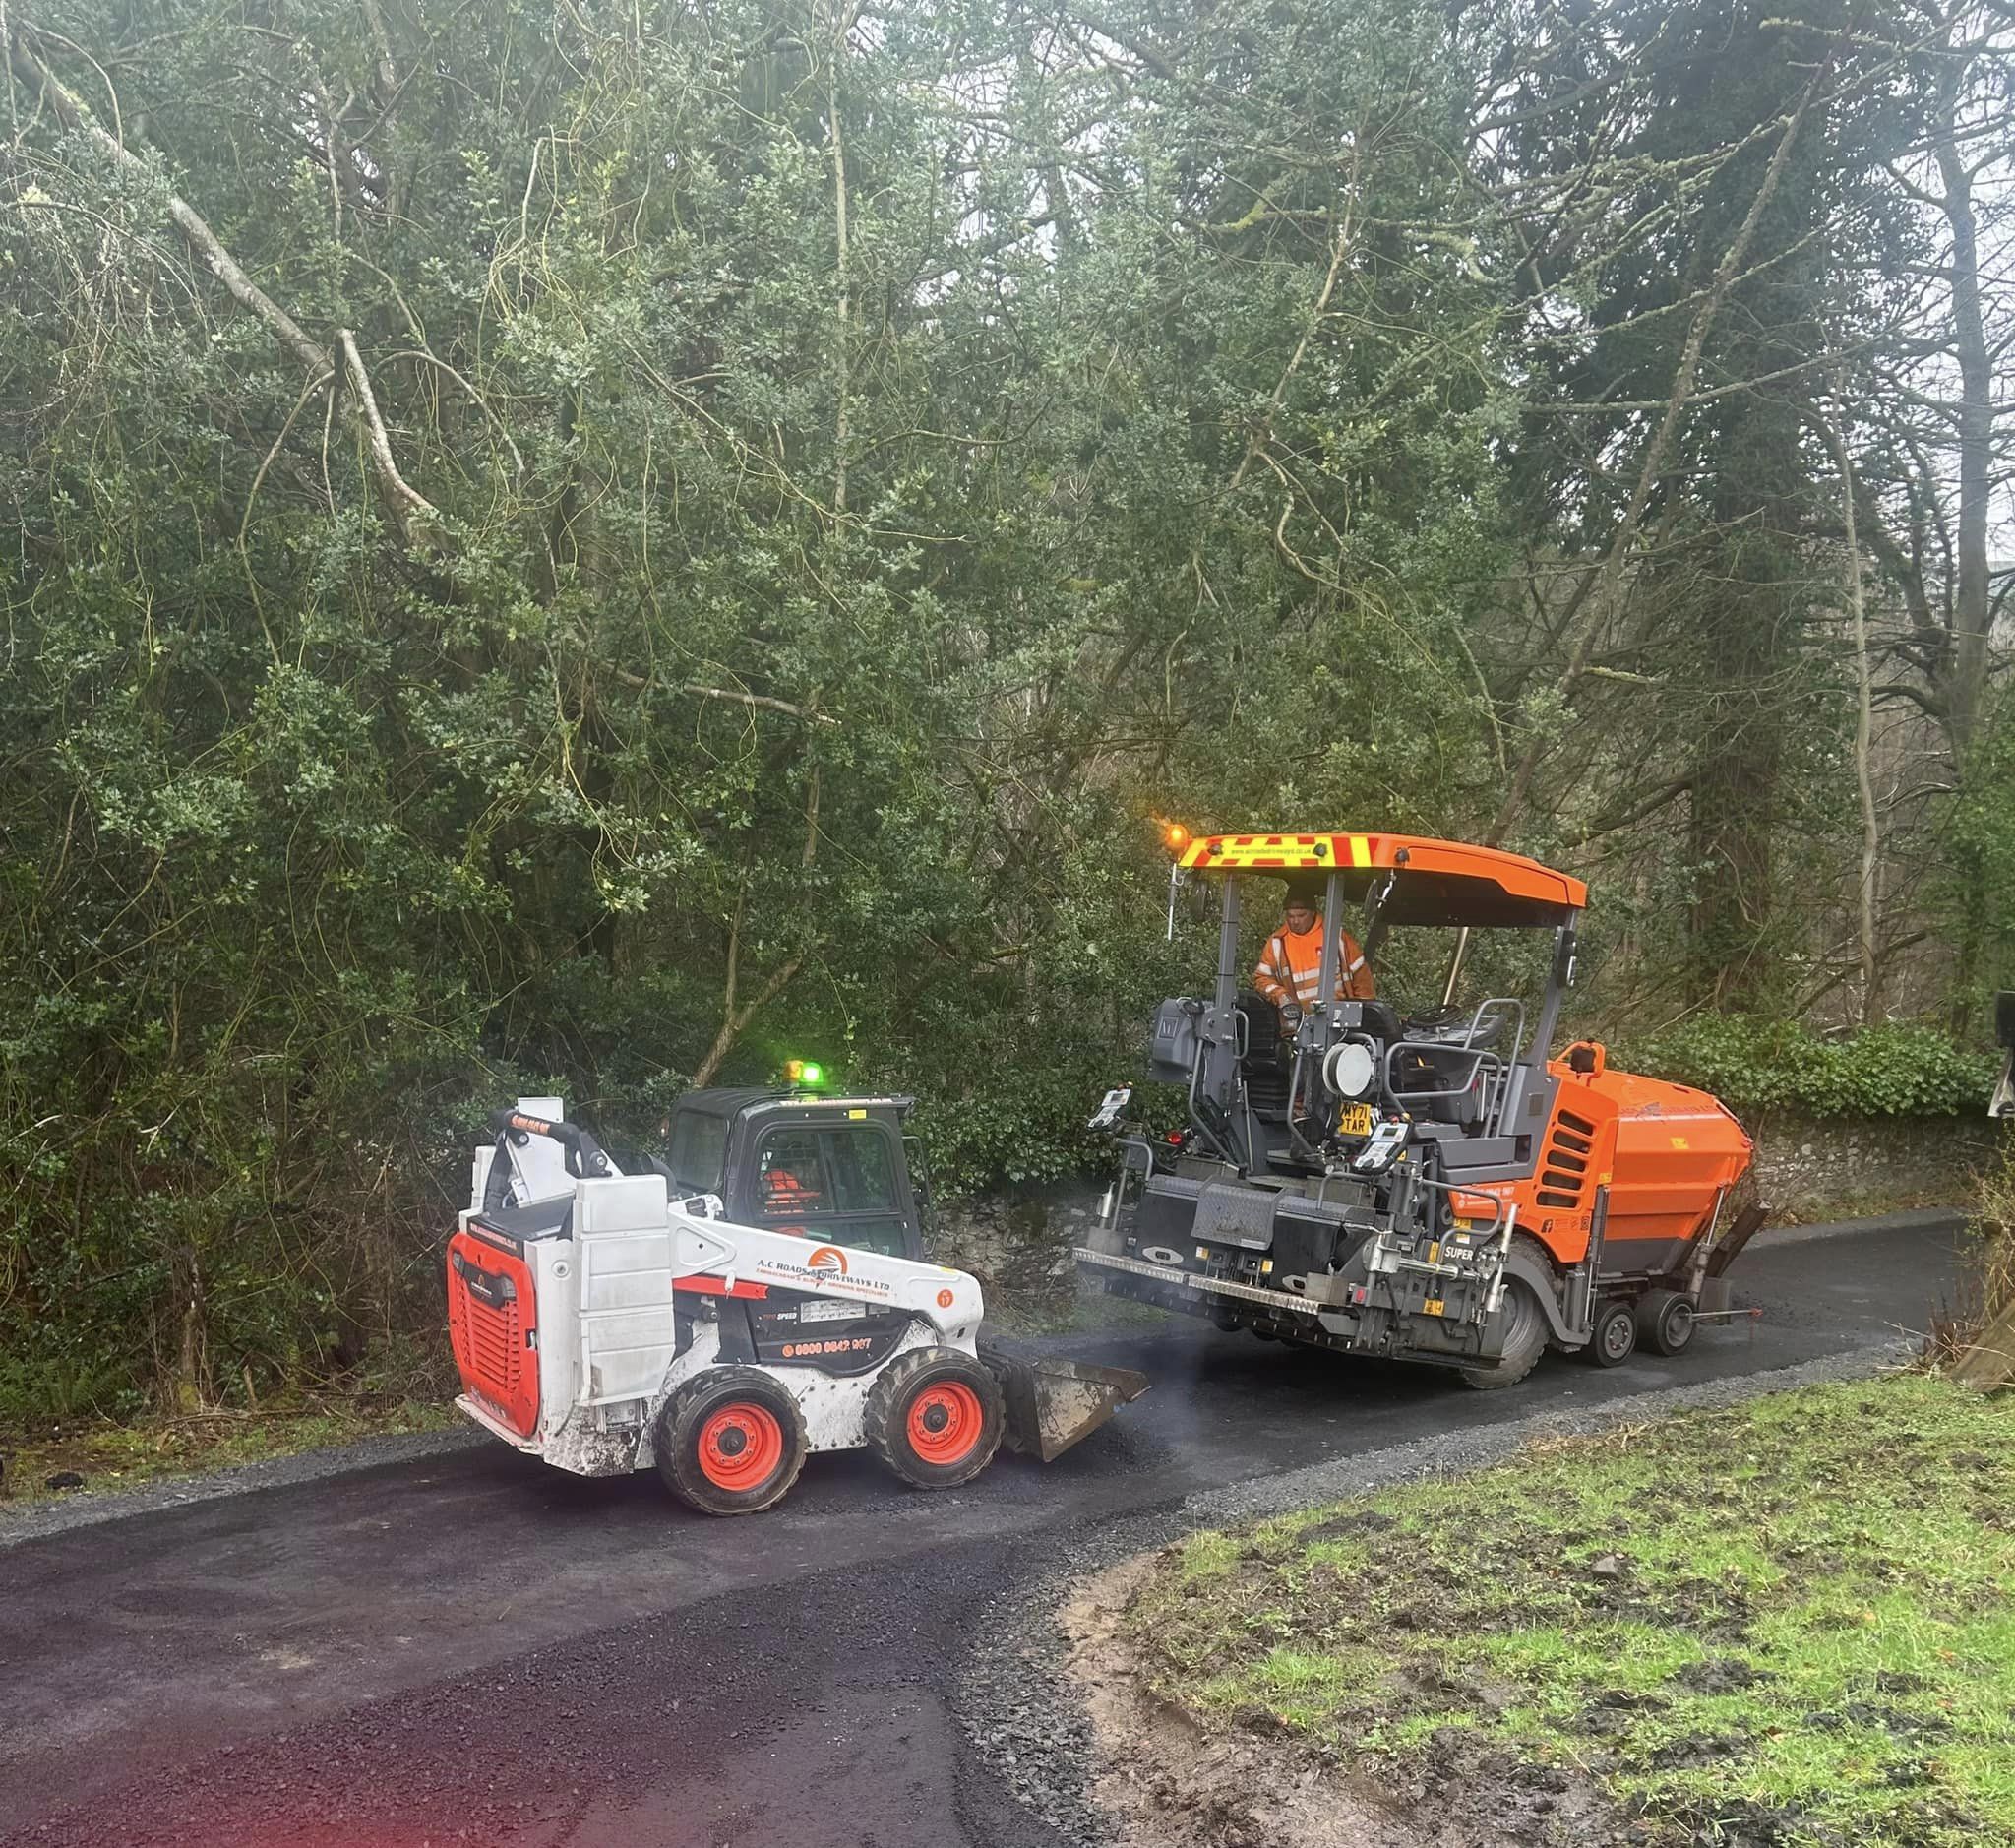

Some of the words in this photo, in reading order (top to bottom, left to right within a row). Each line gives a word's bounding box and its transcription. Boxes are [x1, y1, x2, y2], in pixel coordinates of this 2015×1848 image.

[1346, 1118, 1365, 1132] TAR
[1445, 1246, 1474, 1260] SUPER
[757, 1260, 773, 1268] A.C
[776, 1263, 807, 1274] ROADS
[819, 1270, 872, 1287] DRIVEWAYS
[874, 1281, 890, 1290] LTD
